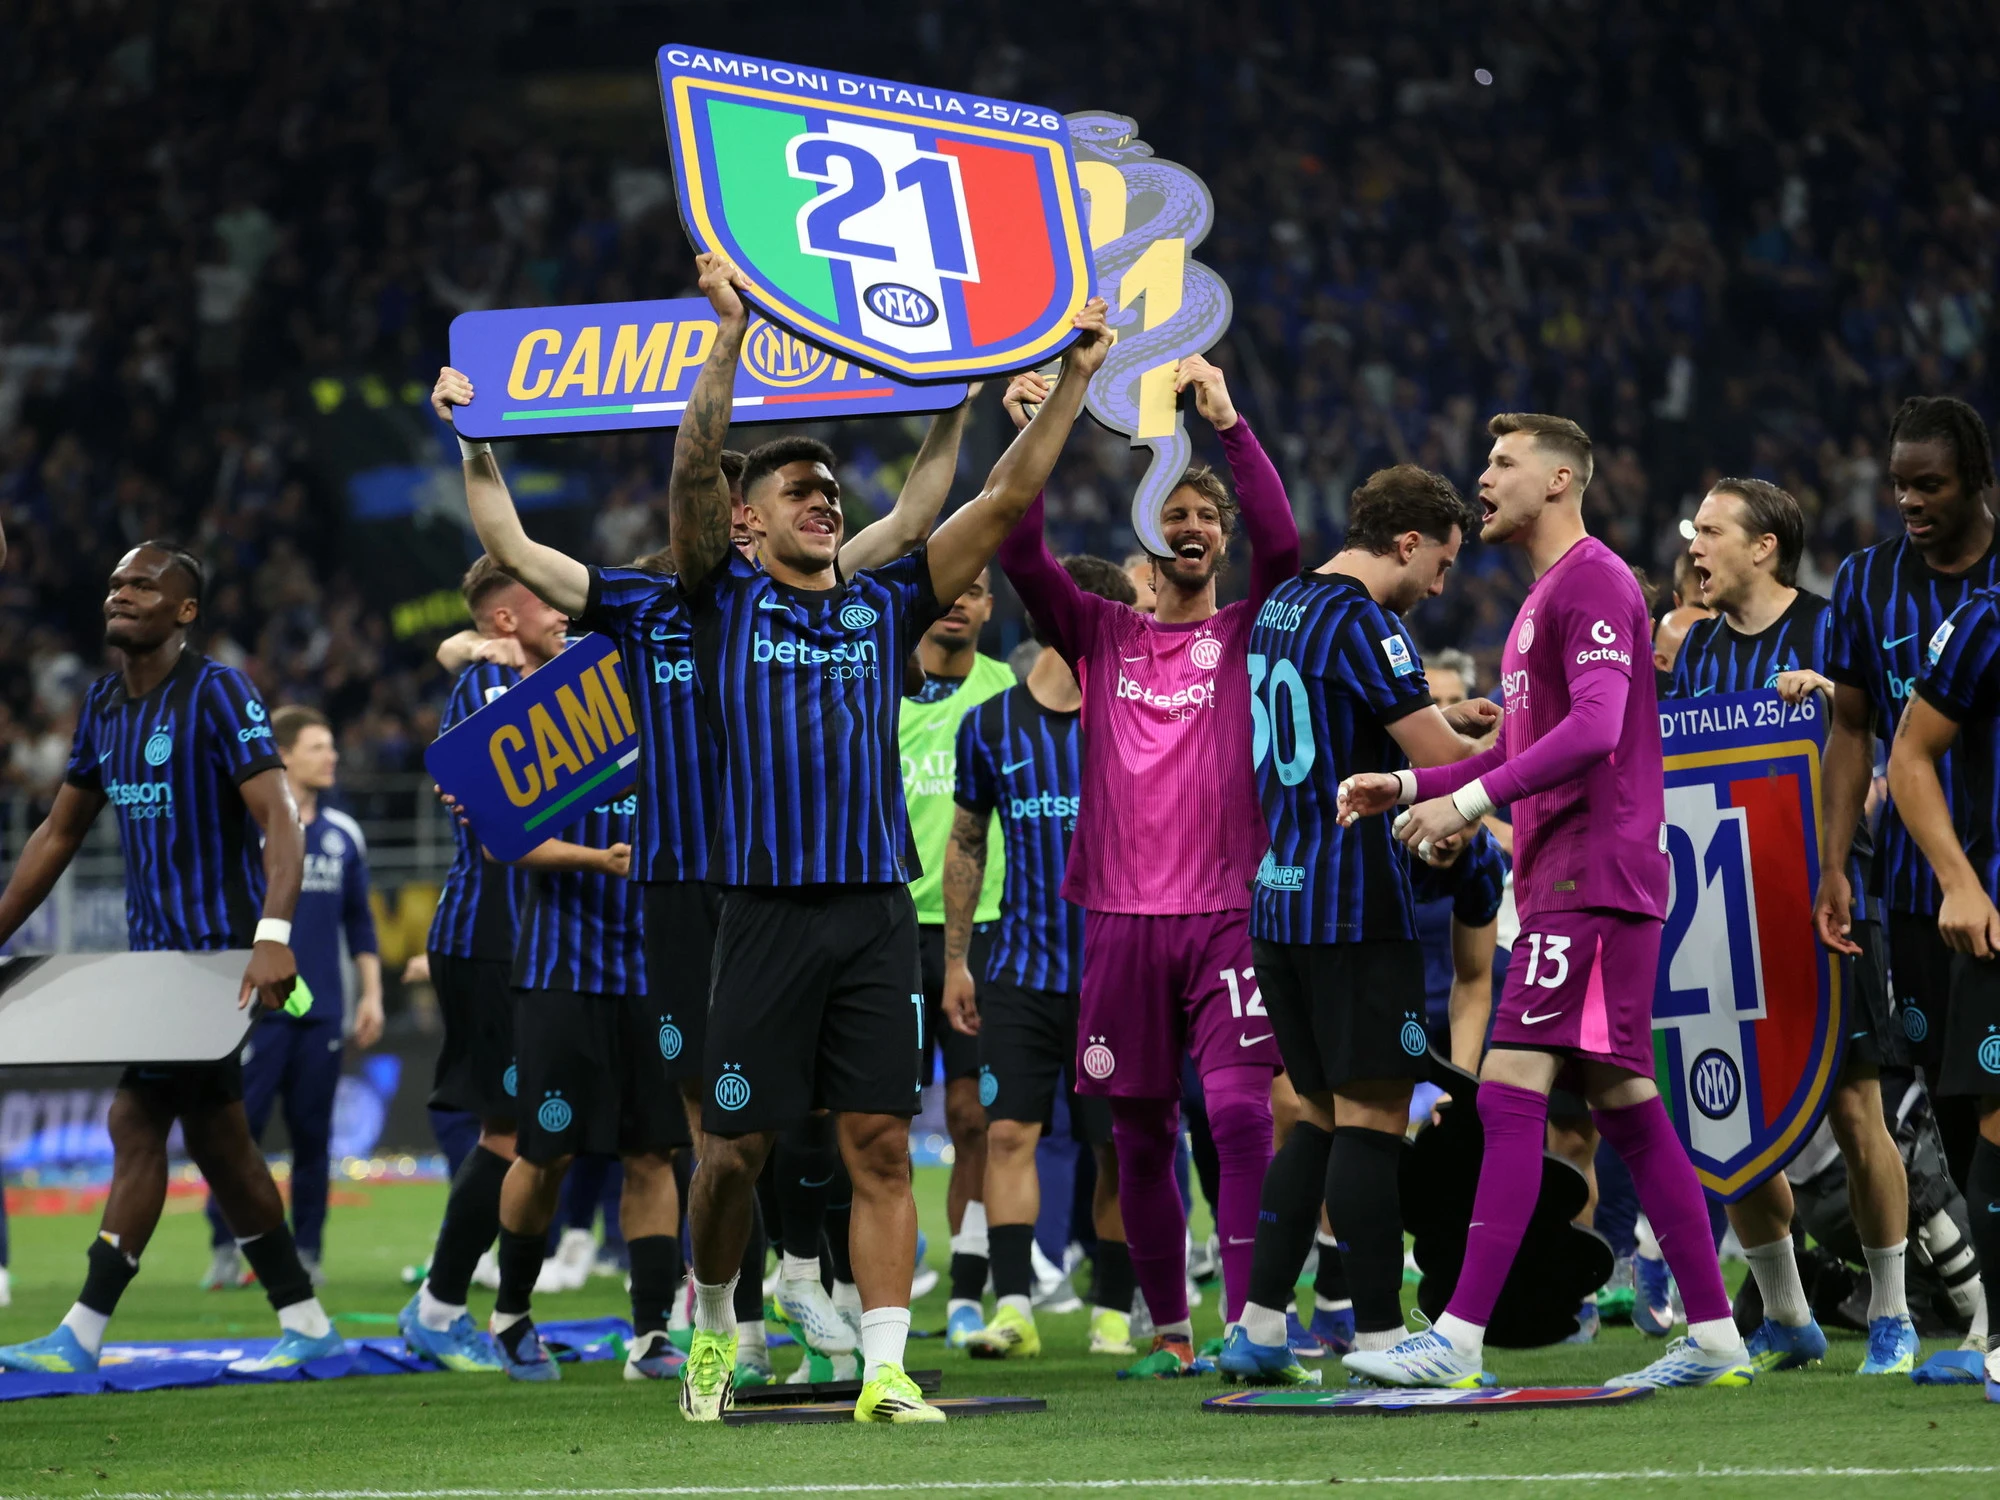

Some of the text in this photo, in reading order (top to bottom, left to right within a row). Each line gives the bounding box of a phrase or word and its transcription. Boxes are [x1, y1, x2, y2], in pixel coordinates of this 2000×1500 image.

[667, 50, 828, 92] CAMPIONI
[973, 102, 1060, 131] 25/26
[795, 139, 969, 276] 21
[1256, 599, 1307, 632] CARLOS
[653, 655, 694, 684] be
[1576, 648, 1631, 666] Gate.io
[1247, 653, 1316, 787] 30
[1652, 817, 1759, 1020] 21
[1524, 932, 1571, 989] 13
[1219, 966, 1269, 1018] 12
